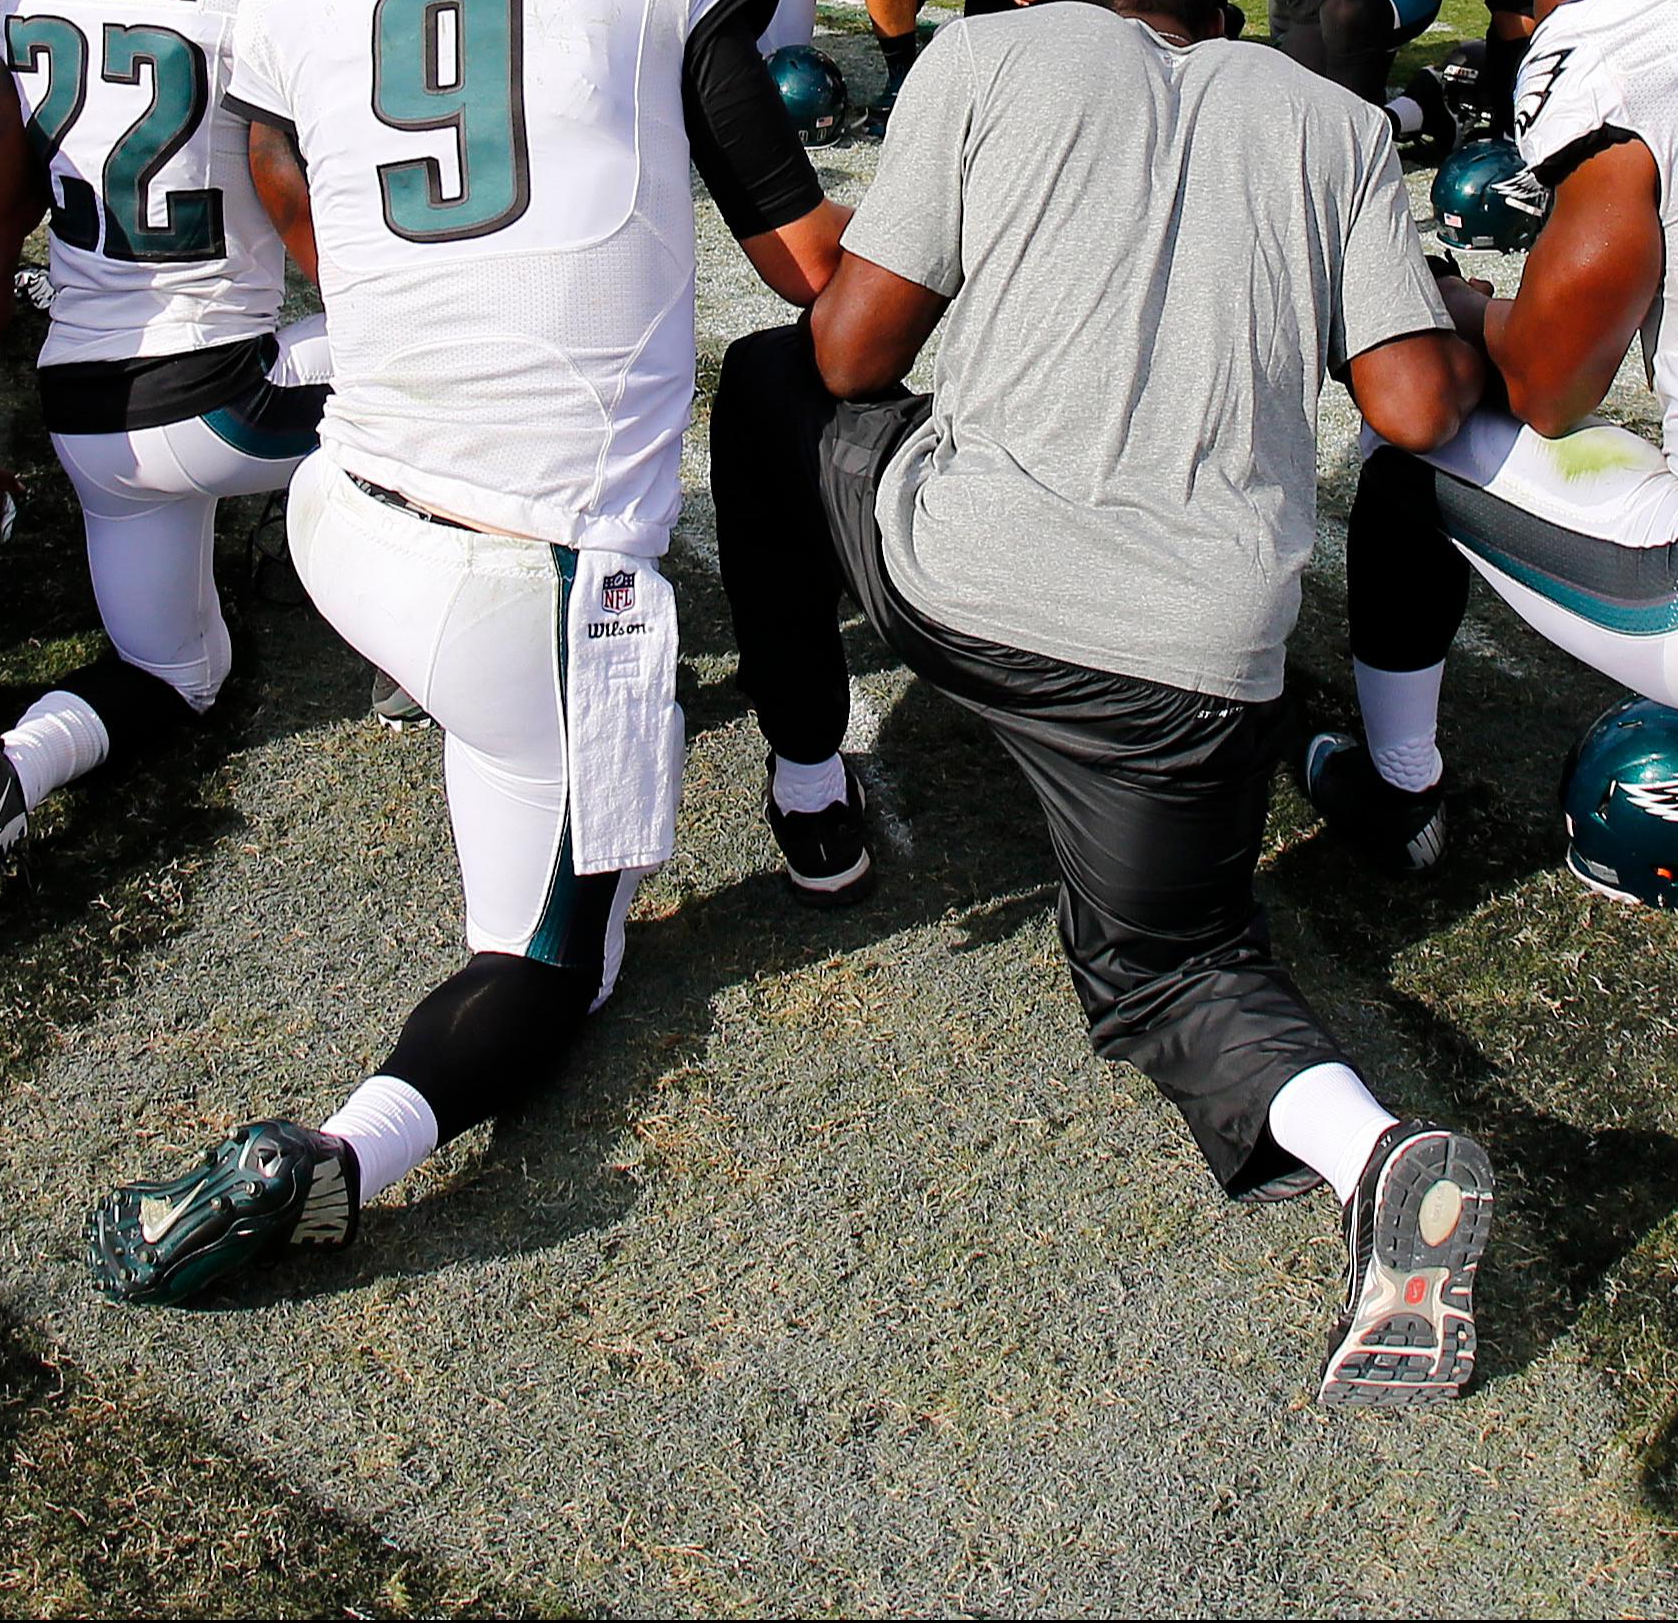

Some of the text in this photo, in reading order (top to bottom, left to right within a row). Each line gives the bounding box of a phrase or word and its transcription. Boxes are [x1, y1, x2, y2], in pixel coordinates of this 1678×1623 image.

[3, 13, 227, 263] 22
[604, 588, 633, 611] NFL
[587, 620, 647, 640] Wilson
